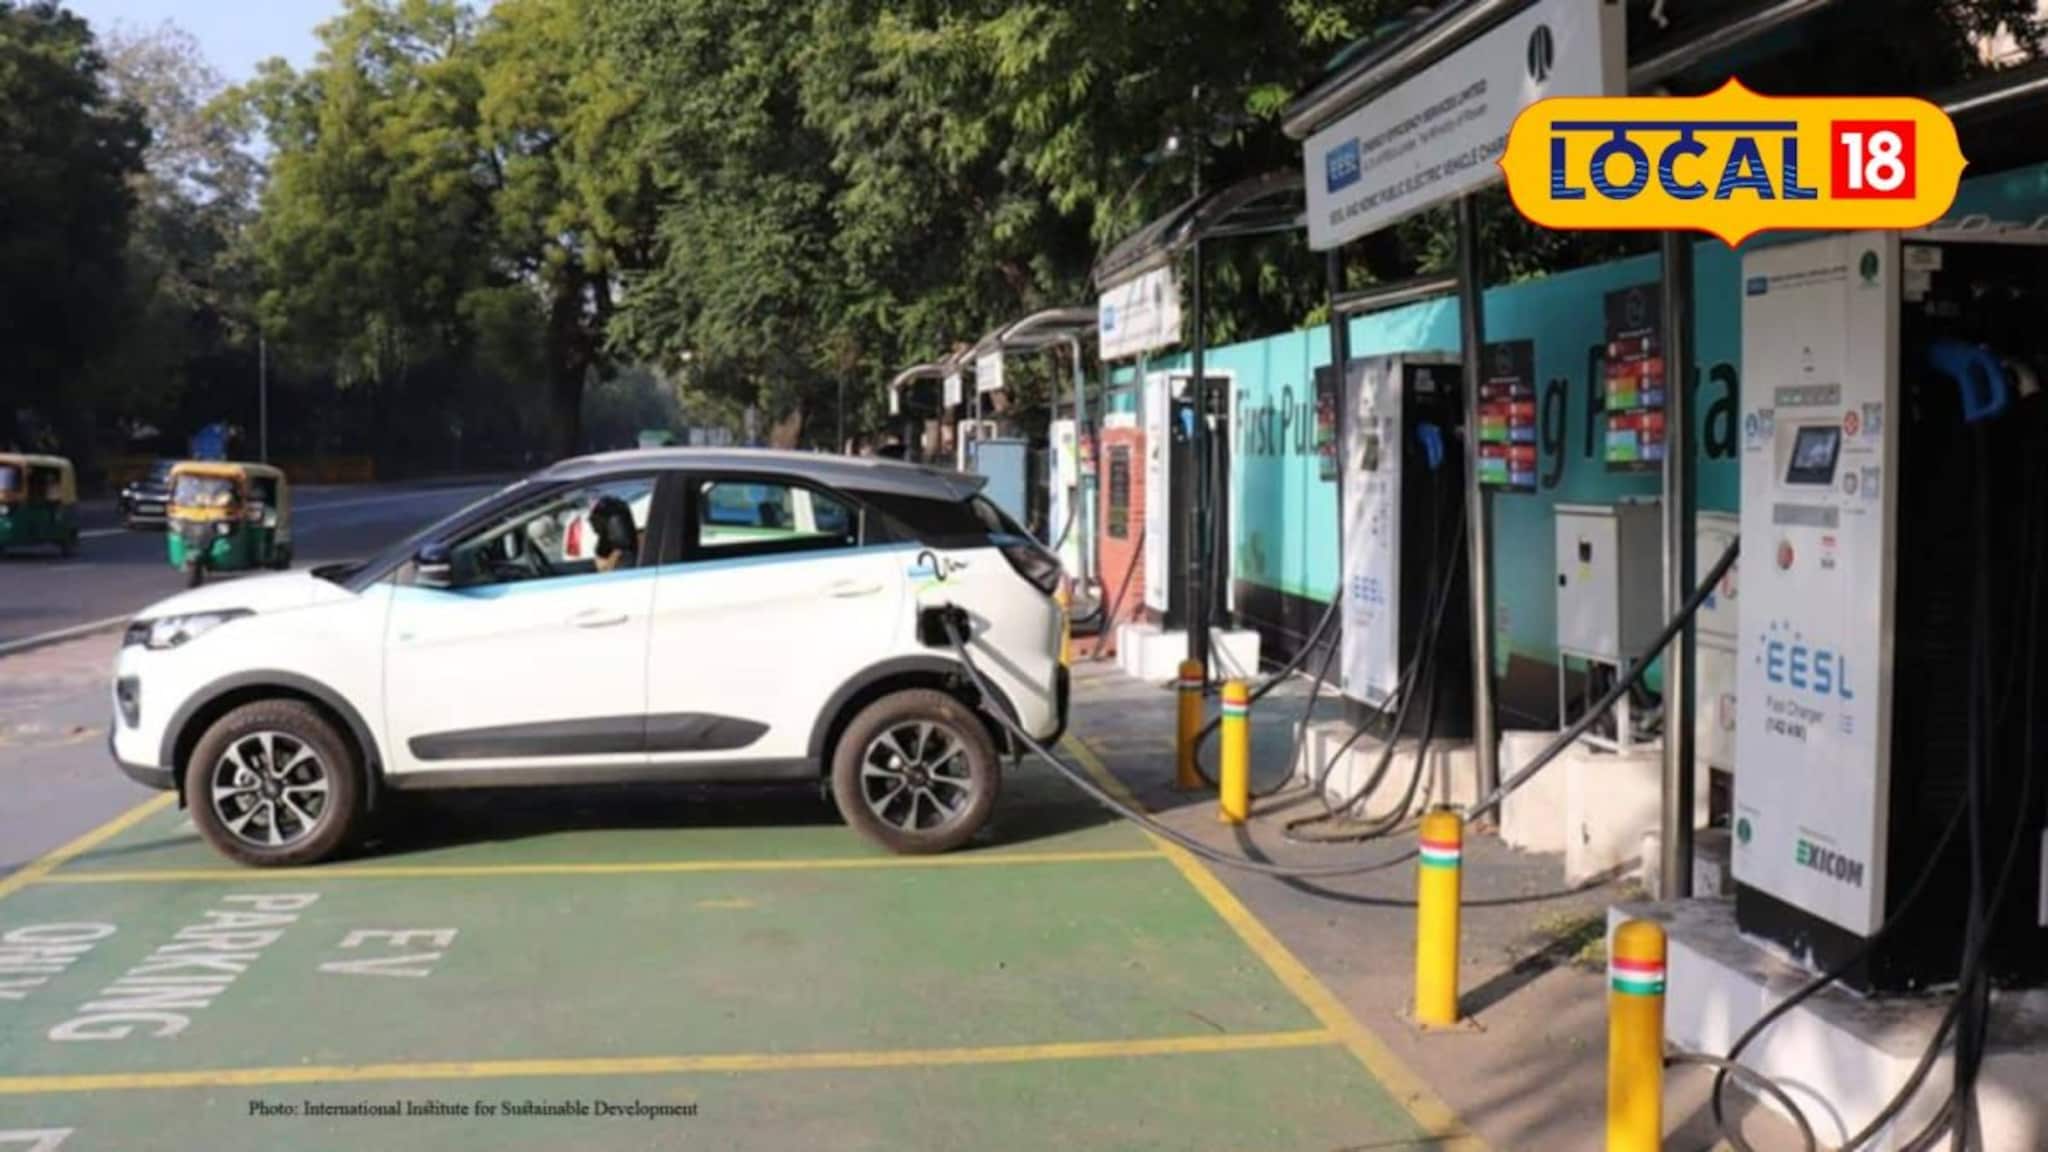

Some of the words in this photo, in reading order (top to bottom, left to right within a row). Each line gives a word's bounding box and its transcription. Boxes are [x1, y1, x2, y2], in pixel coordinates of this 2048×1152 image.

[1768, 641, 1853, 701] EESL
[1796, 838, 1864, 888] EXICOM
[47, 892, 320, 1041] PARKING
[316, 927, 459, 978] EV
